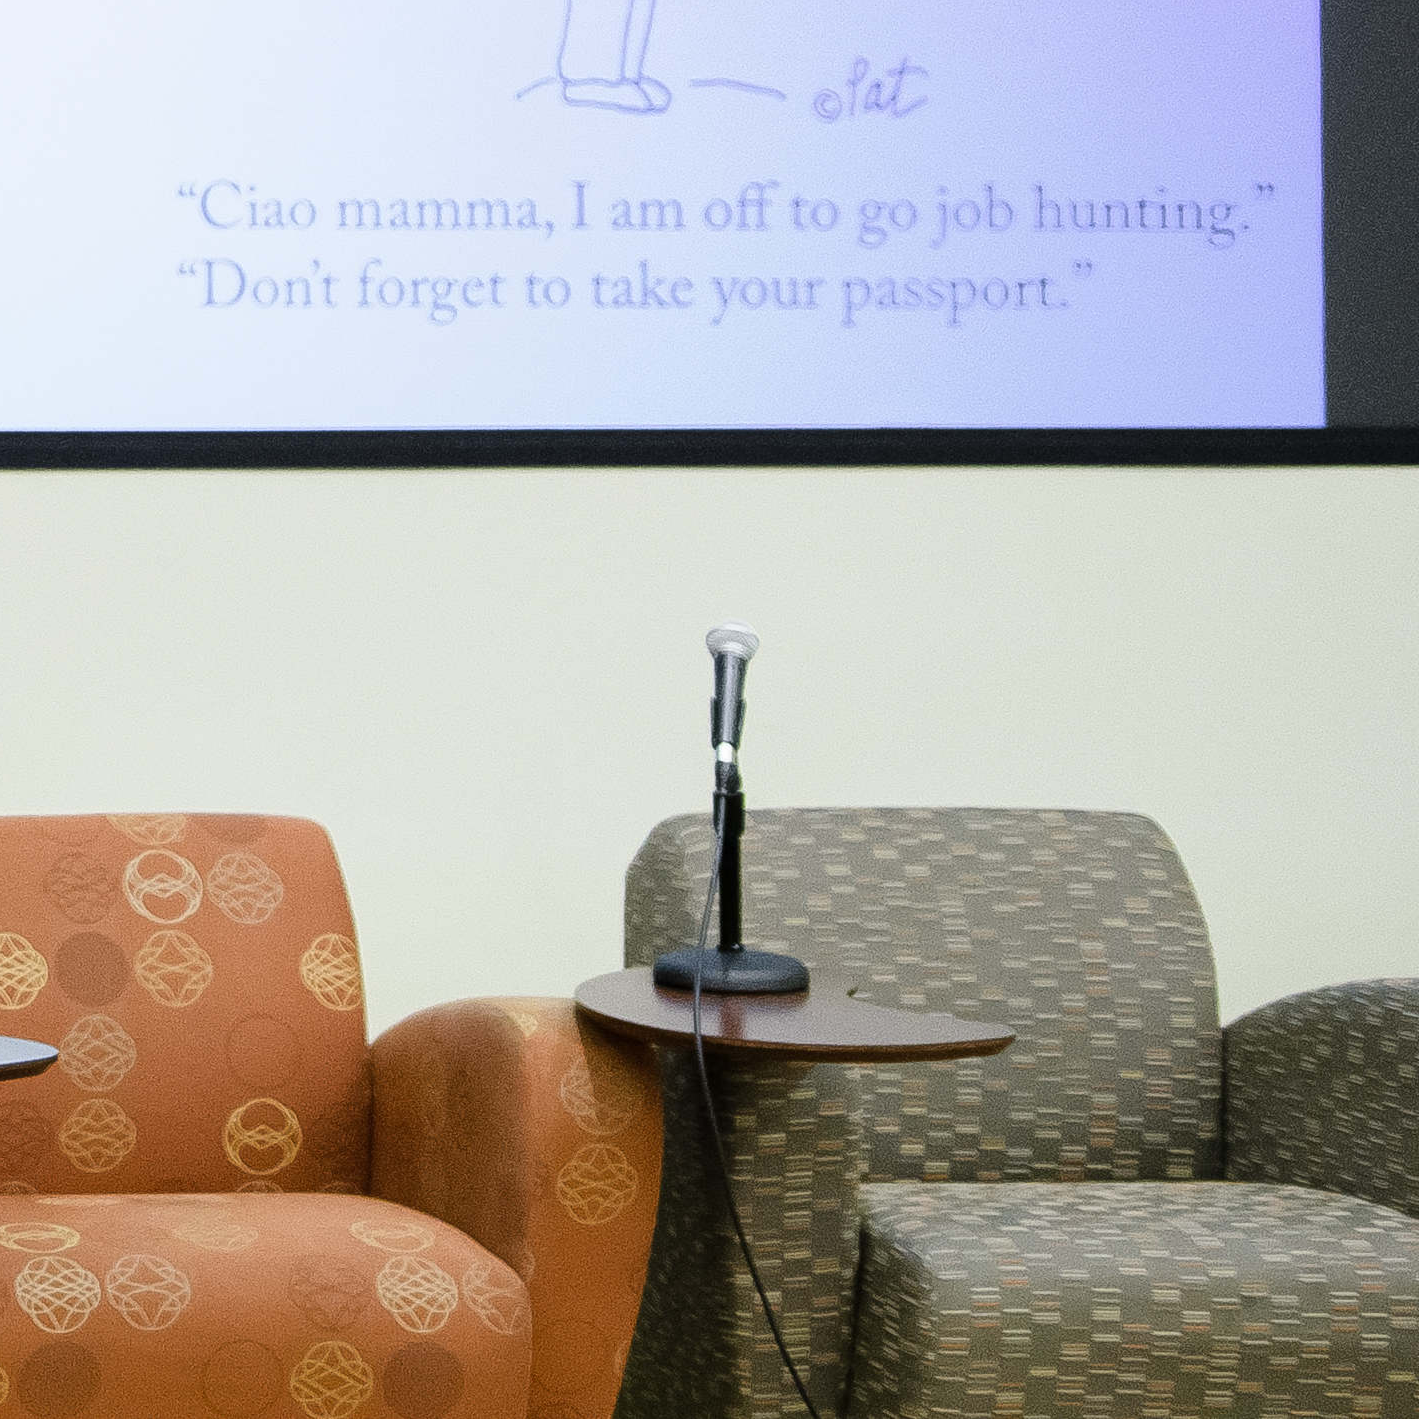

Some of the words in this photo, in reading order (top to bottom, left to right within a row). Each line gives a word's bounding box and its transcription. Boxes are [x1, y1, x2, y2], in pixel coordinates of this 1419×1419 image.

[336, 195, 557, 241] mamma,
[569, 179, 593, 233] I
[609, 196, 689, 233] am
[703, 179, 783, 233] off
[790, 187, 843, 233] to
[855, 197, 921, 253] go
[927, 180, 1017, 253] job
[356, 257, 508, 328] forget
[522, 267, 574, 311] to
[588, 257, 697, 312] take
[709, 274, 827, 328] your
